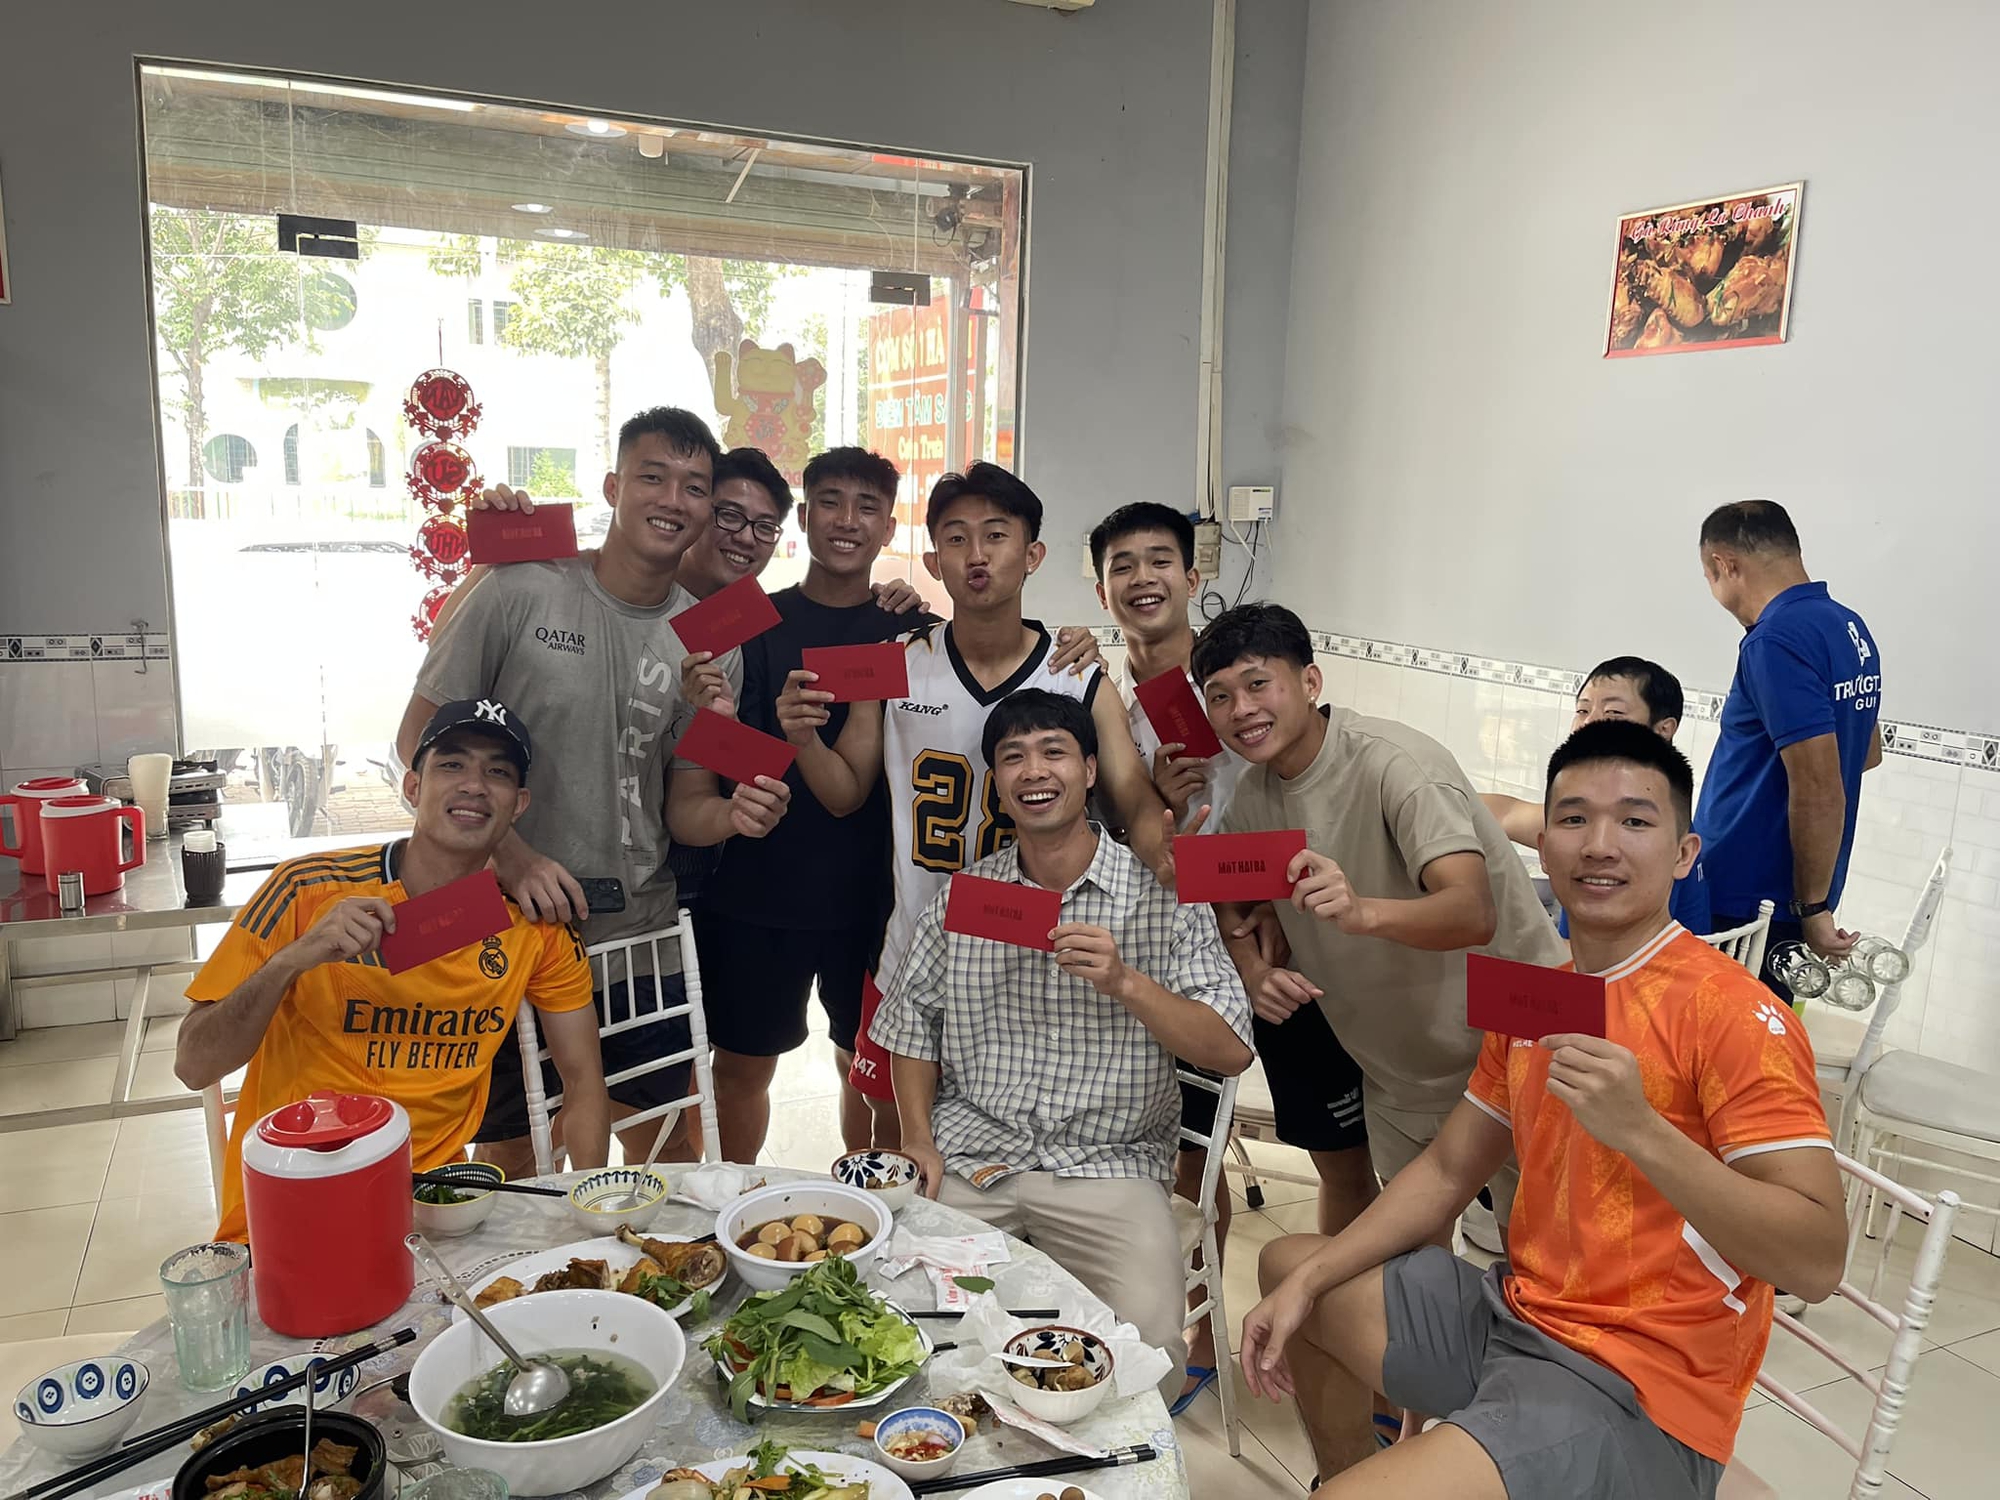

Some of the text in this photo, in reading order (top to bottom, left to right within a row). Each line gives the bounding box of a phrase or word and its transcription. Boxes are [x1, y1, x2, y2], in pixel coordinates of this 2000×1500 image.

[535, 626, 586, 648] QATAR
[547, 641, 586, 656] AIRWAYS
[474, 699, 507, 726] NY
[616, 657, 673, 846] PARIS
[343, 999, 505, 1037] Emirates
[366, 1041, 479, 1069] FLY BETTER
